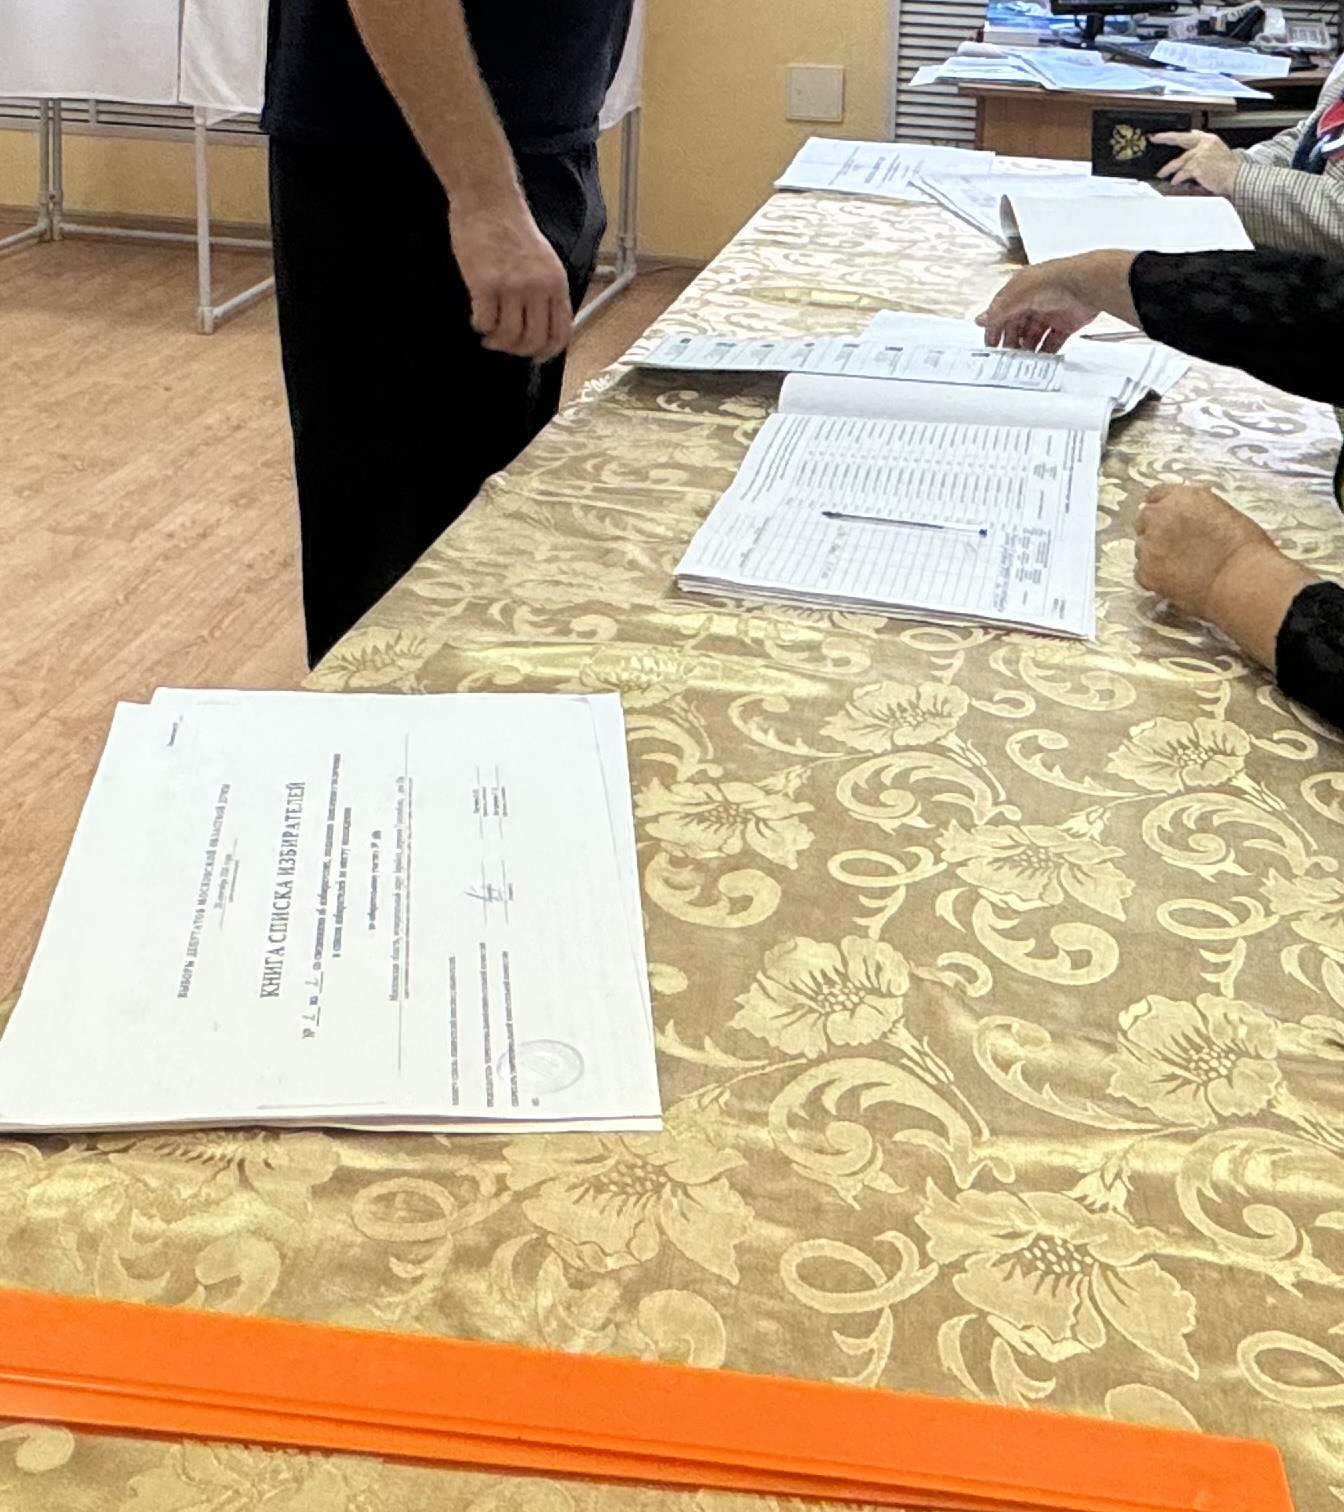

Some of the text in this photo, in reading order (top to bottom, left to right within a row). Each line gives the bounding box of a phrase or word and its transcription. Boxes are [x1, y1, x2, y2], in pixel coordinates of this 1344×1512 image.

[259, 781, 306, 998] КНИГА СПИСКА ИЗБИРАТЕЛЕЙ
